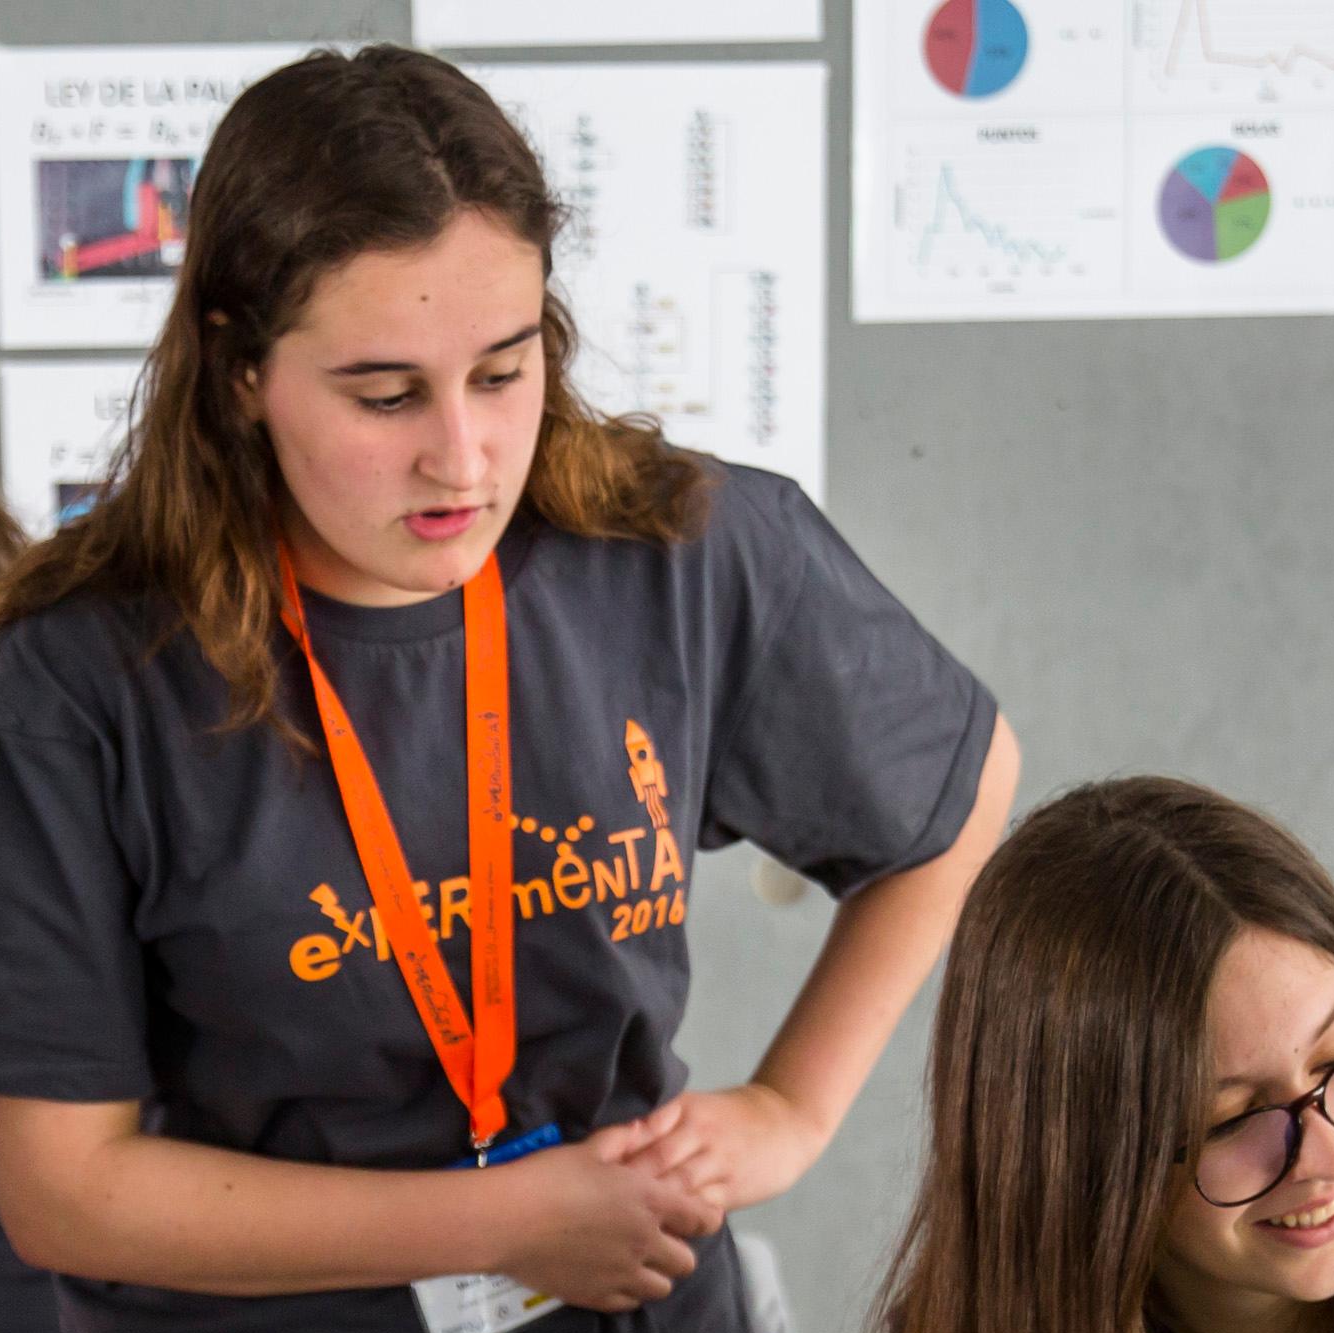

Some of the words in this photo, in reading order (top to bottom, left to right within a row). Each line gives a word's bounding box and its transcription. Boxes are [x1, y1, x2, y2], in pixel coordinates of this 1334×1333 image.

[44, 76, 95, 108] LEY
[98, 76, 138, 108] DE
[142, 76, 174, 107] LA
[611, 890, 685, 943] 2016
